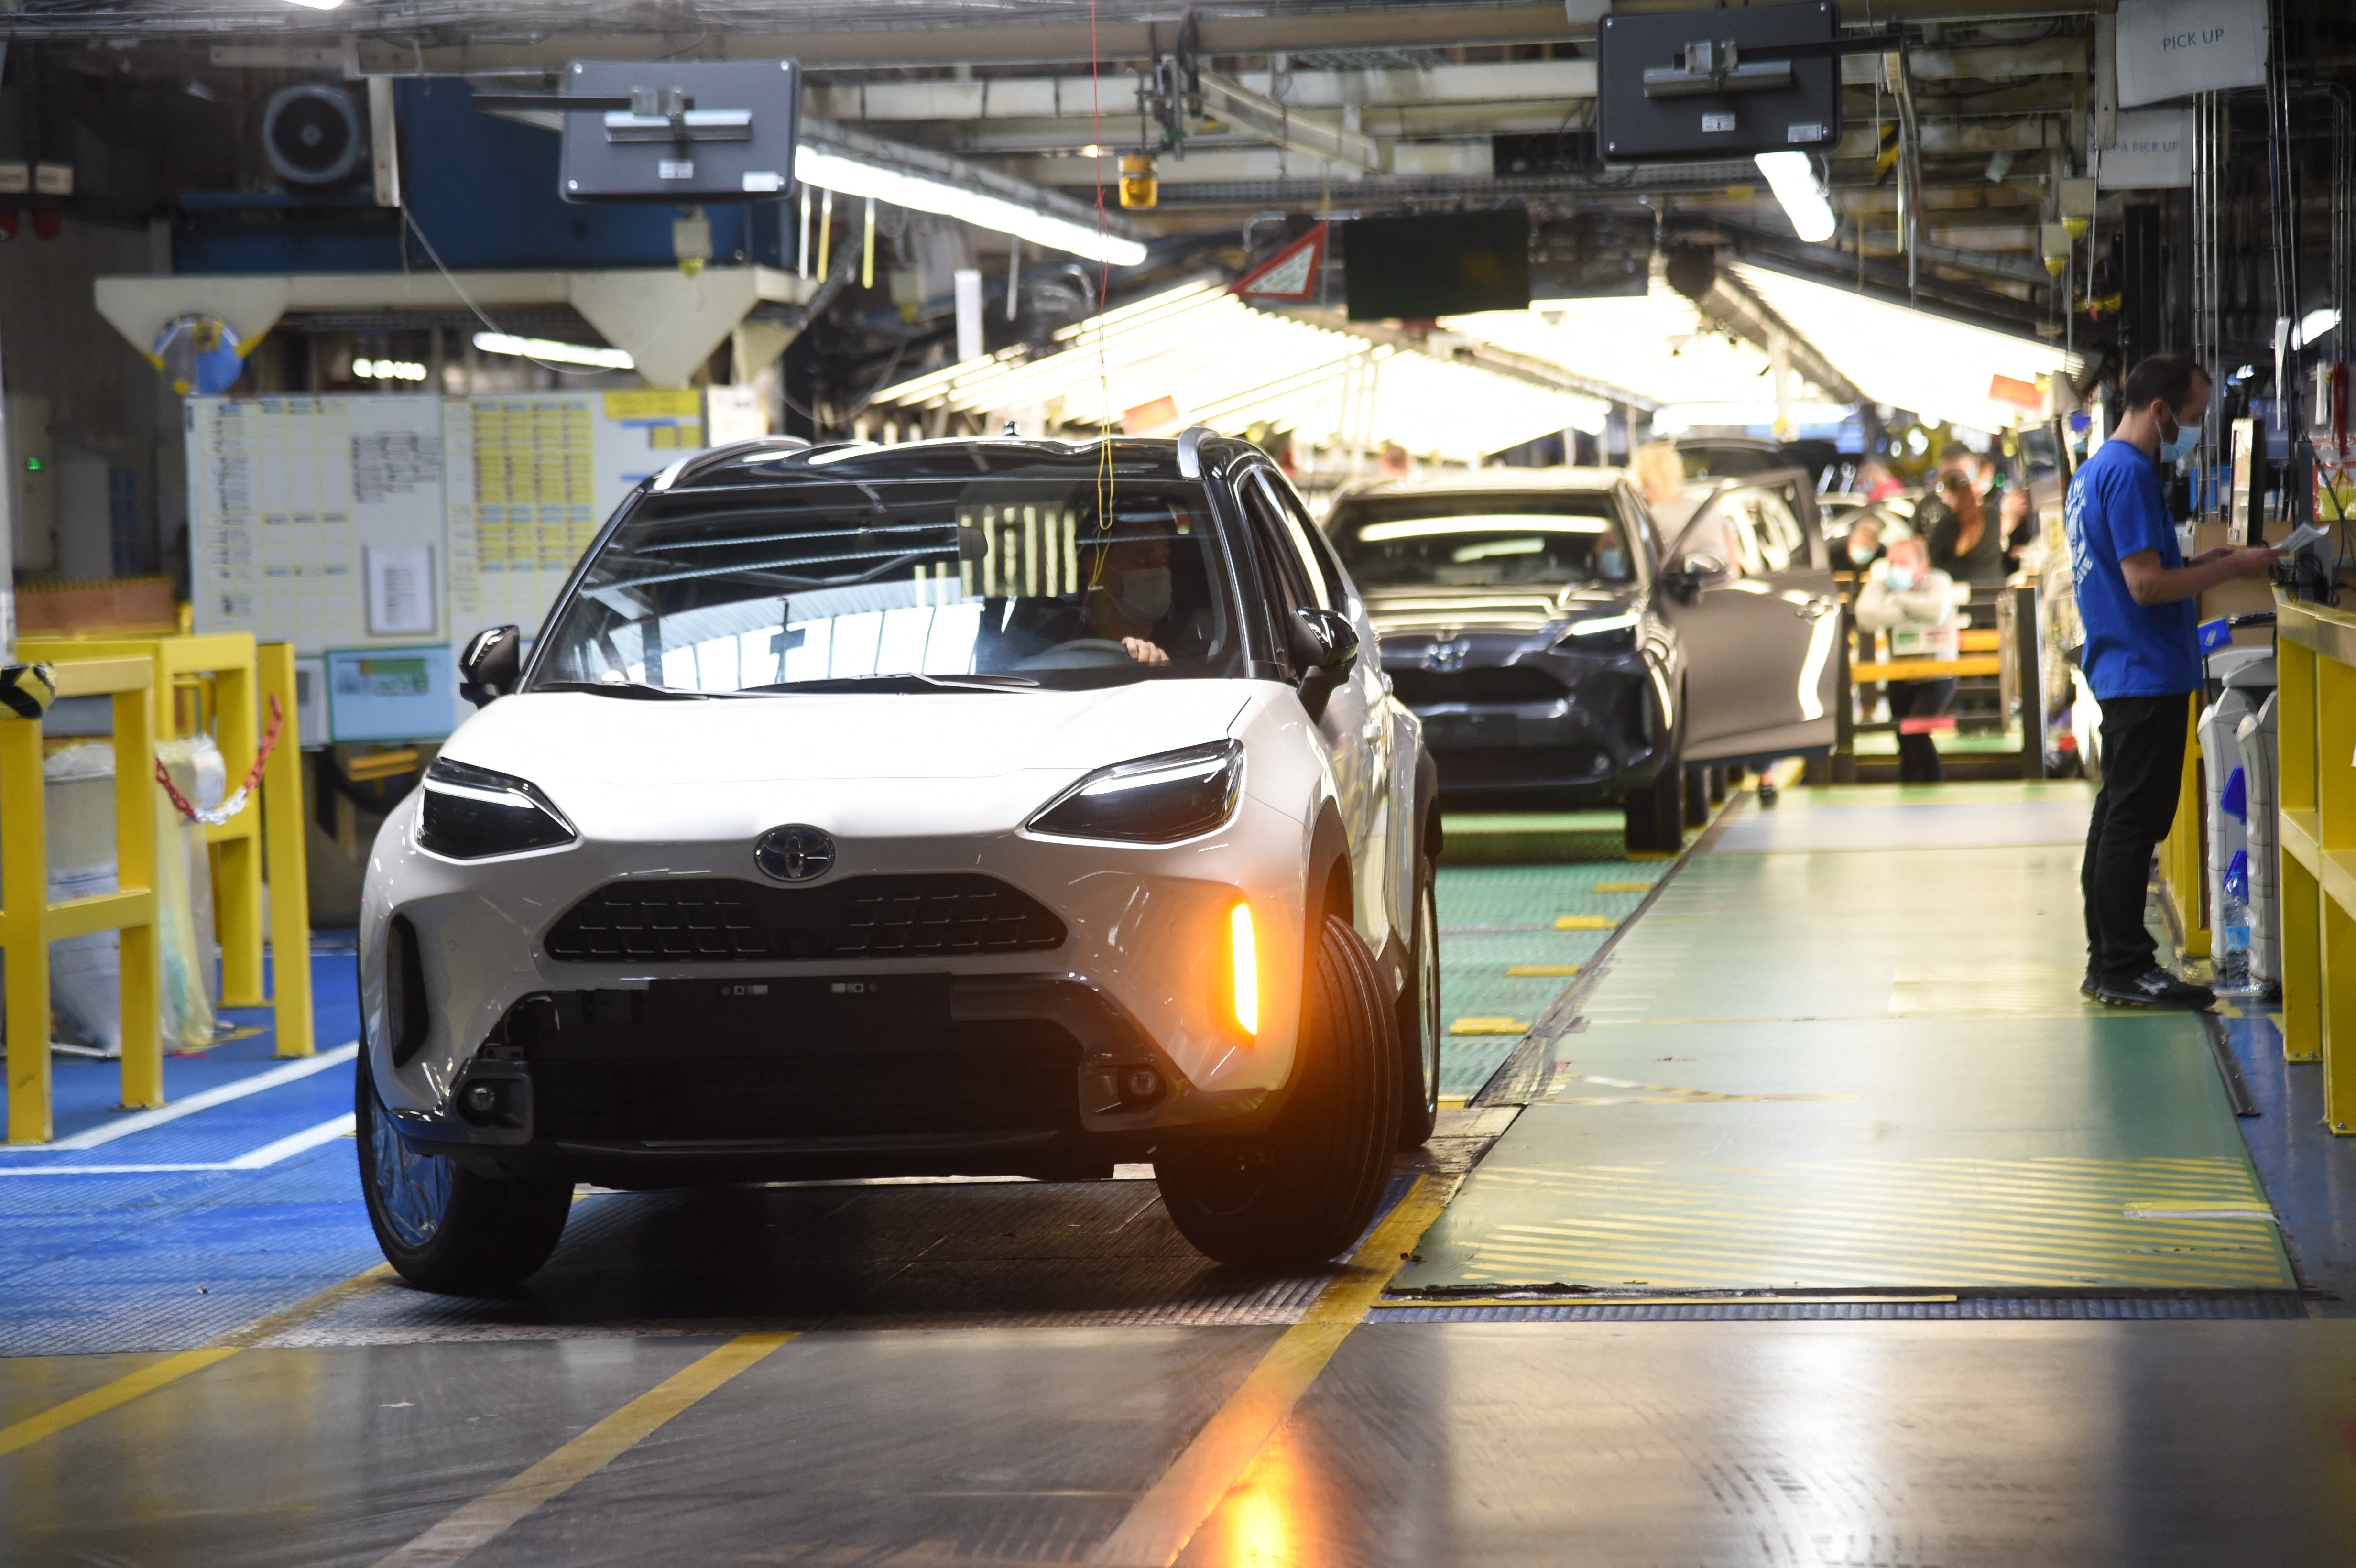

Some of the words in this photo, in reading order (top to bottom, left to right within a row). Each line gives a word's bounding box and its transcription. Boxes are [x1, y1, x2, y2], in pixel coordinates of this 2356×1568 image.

[2163, 31, 2197, 51] PICK
[2202, 28, 2224, 44] UP
[2133, 141, 2160, 152] PICK
[2163, 141, 2179, 152] UP
